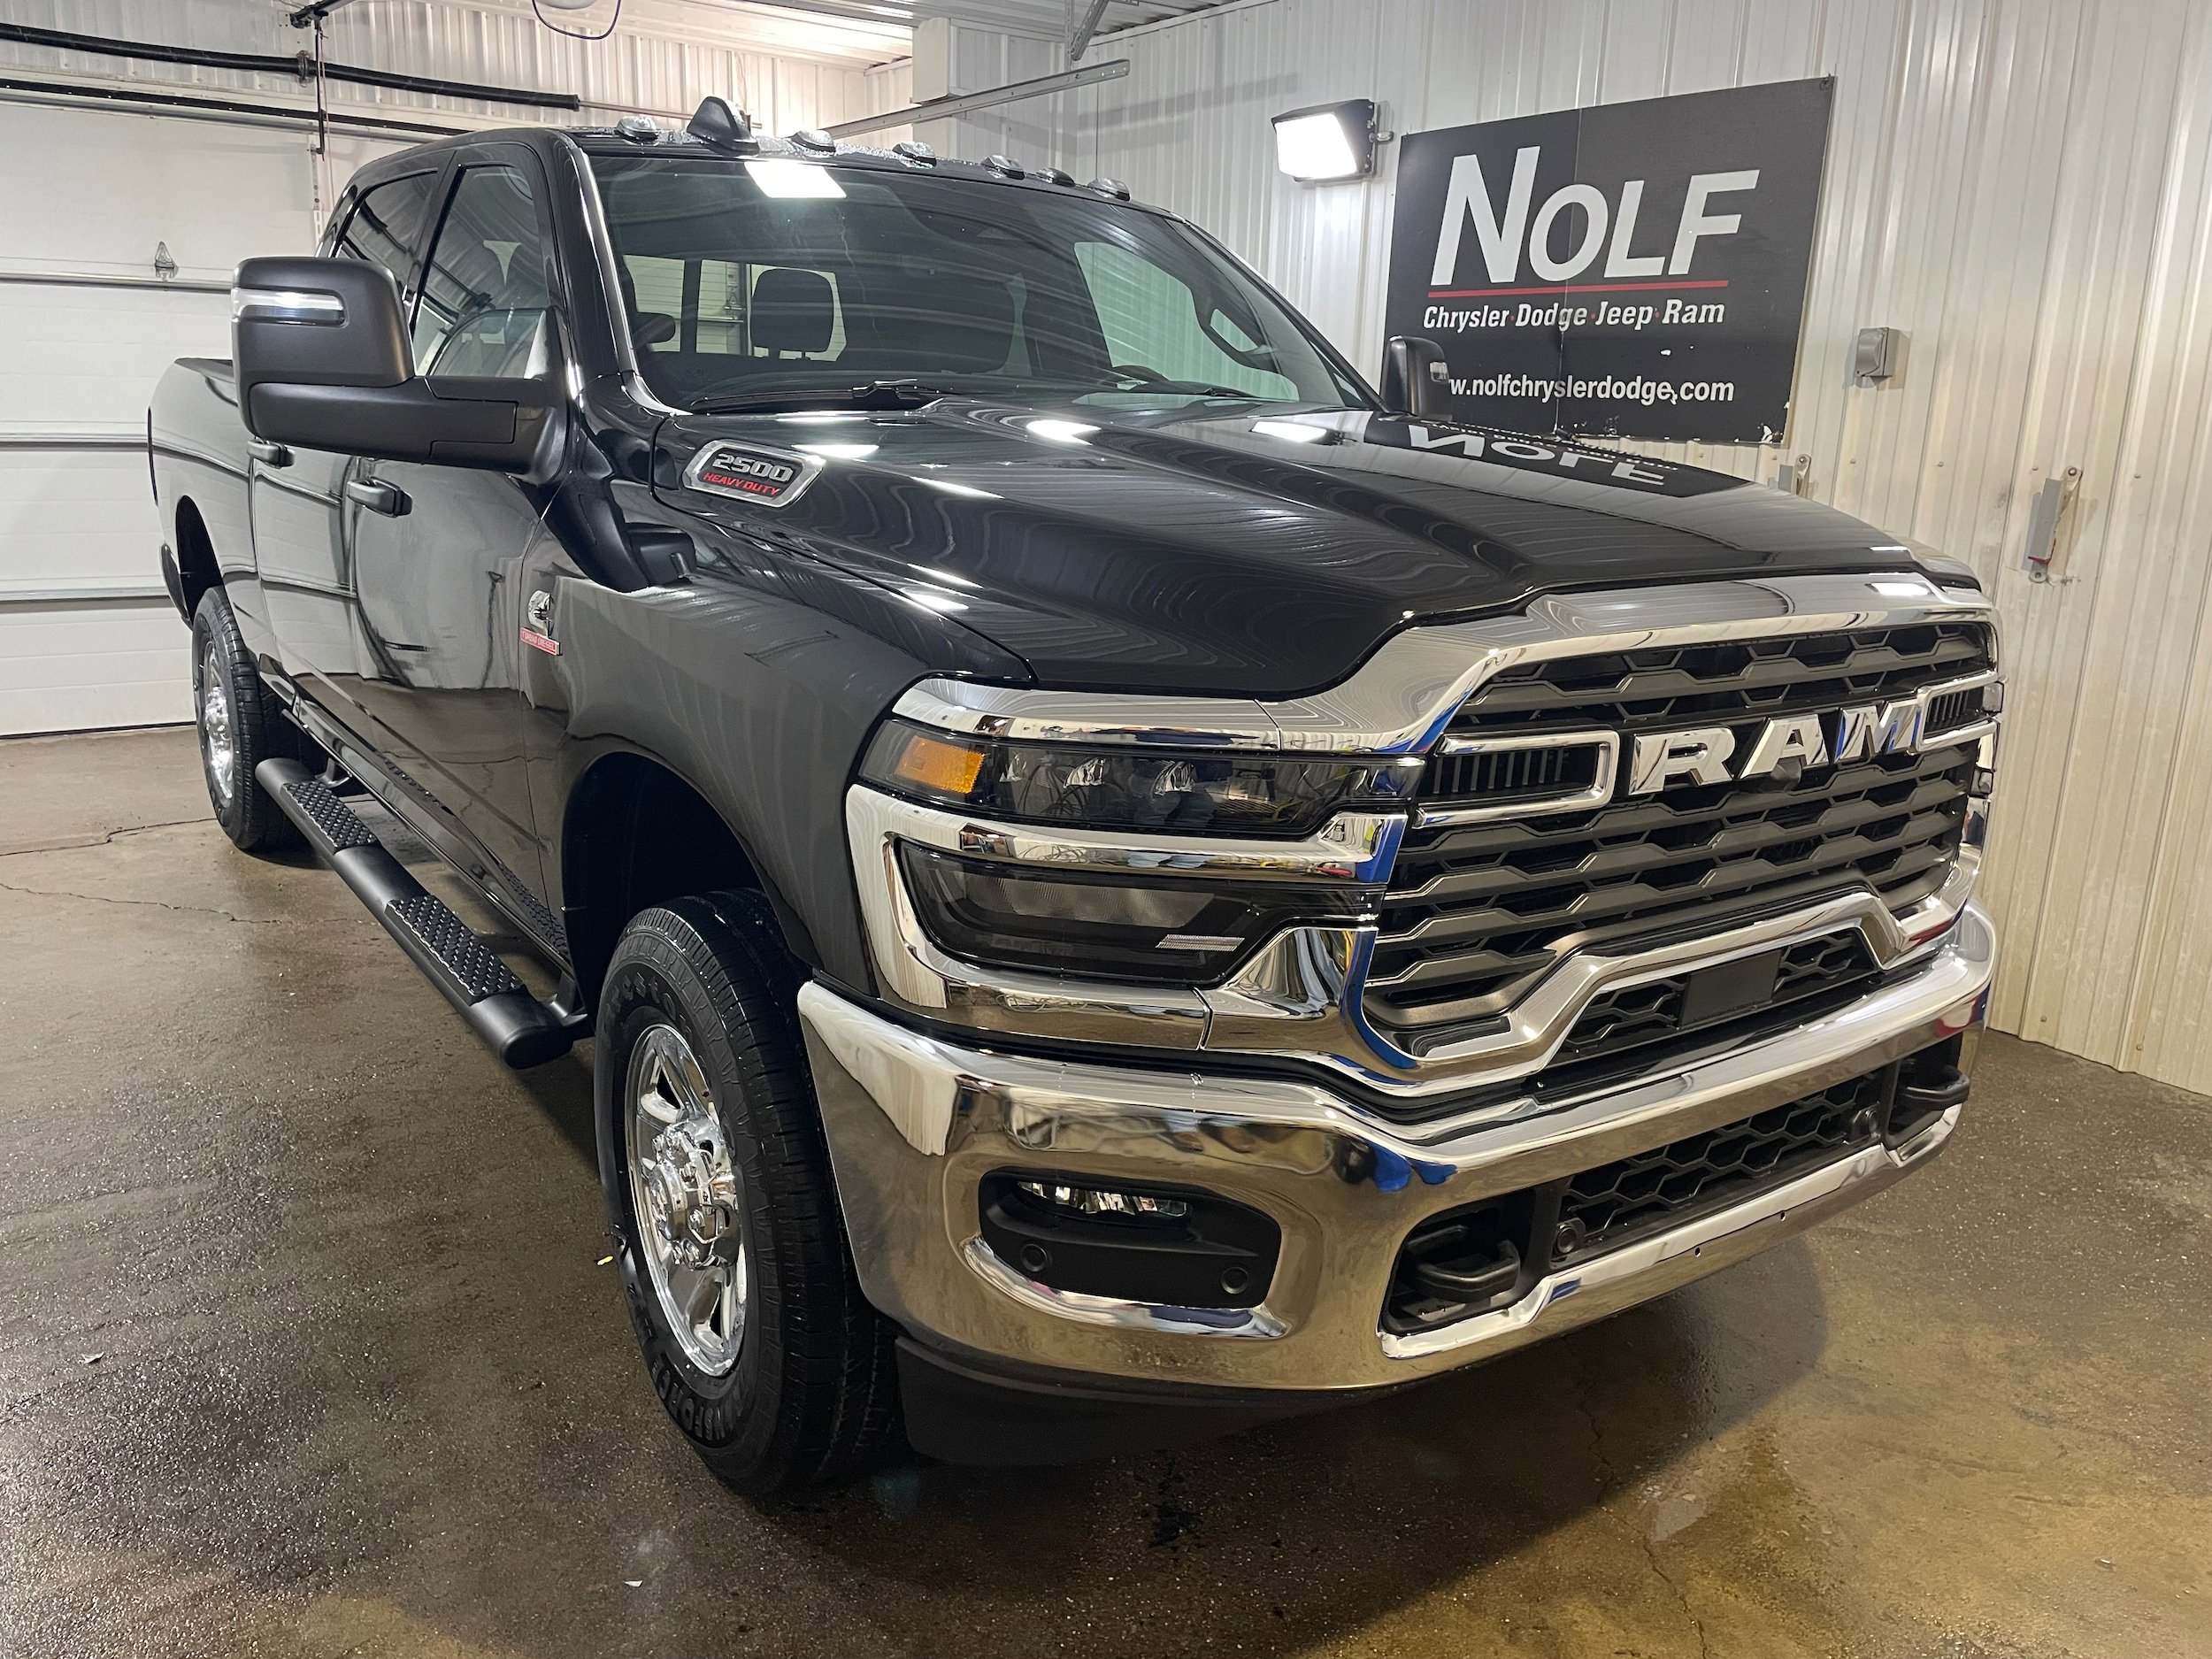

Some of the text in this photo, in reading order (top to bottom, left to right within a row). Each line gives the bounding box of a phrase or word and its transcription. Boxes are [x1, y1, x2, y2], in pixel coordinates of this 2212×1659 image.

[1431, 145, 1761, 286] NOLF
[1423, 298, 1725, 334] Chrysler Dodge Jeep Ram
[703, 472, 781, 496] HEAVY DUTY
[712, 452, 794, 482] 2500
[1628, 699, 1922, 795] RAM
